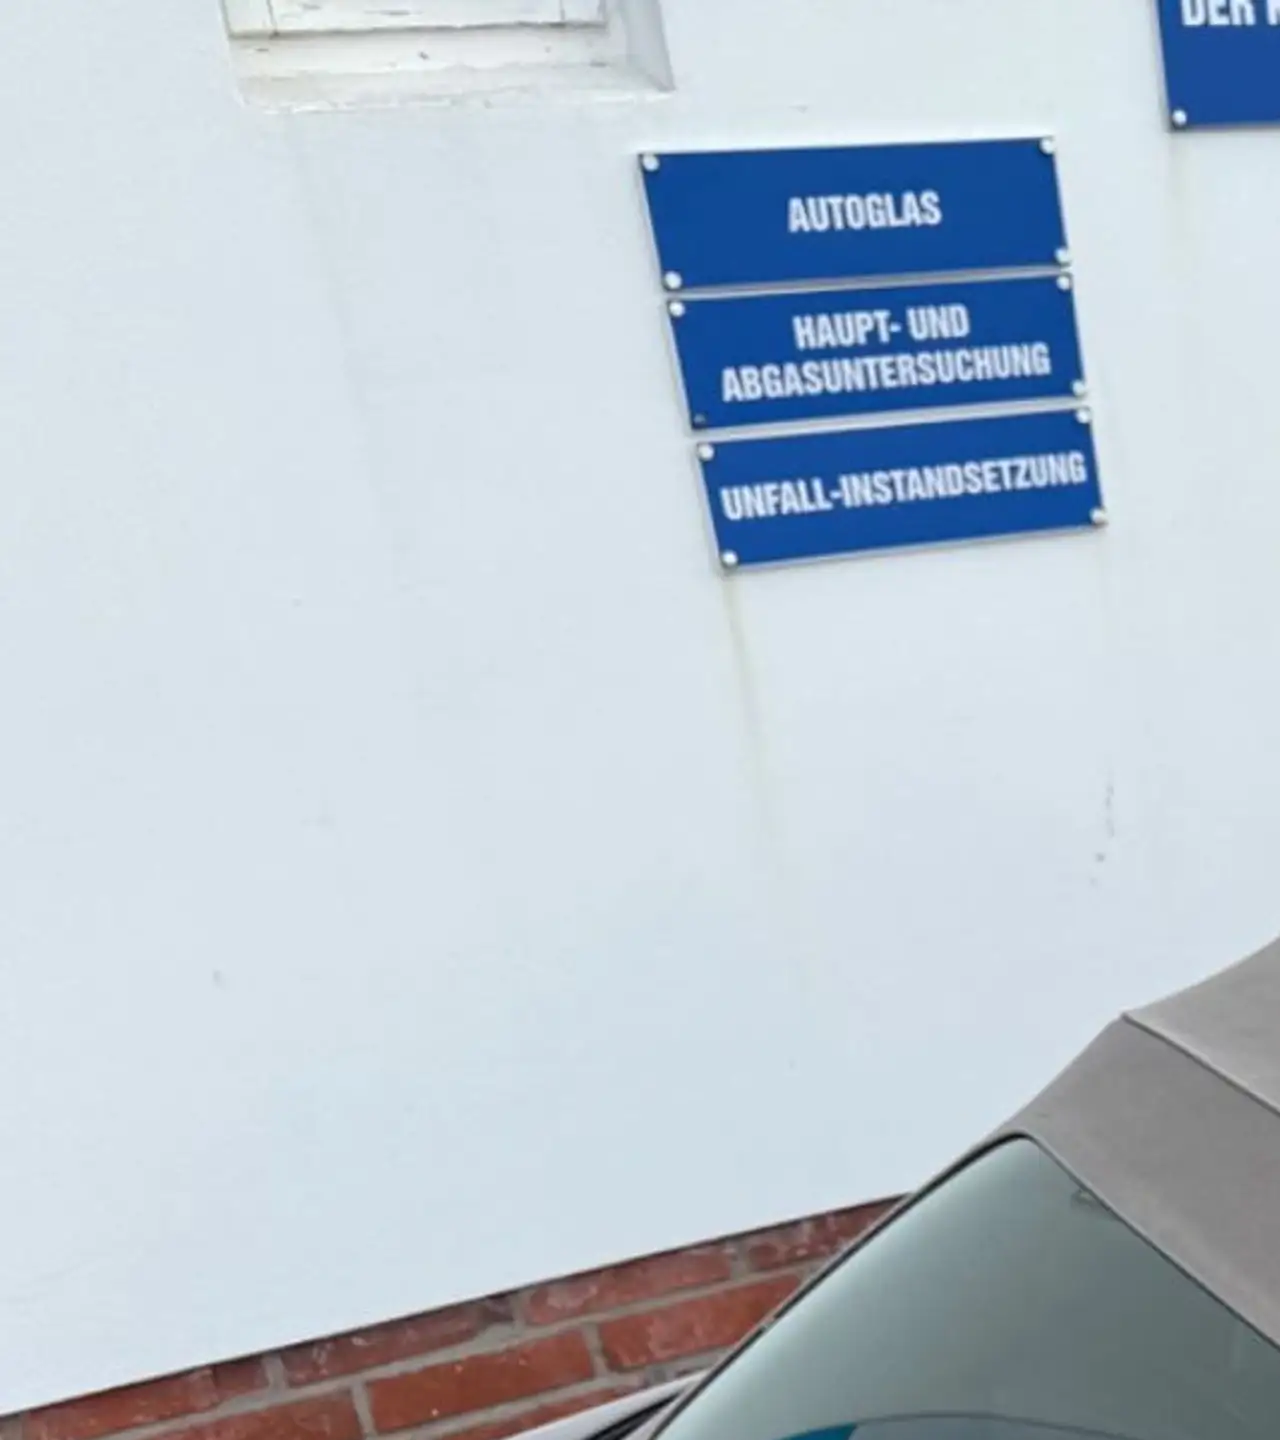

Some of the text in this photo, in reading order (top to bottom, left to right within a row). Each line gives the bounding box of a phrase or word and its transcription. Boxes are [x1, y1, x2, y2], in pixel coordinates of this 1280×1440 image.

[1180, 0, 1256, 26] DER
[788, 190, 943, 233] AUTOGLAS
[792, 304, 970, 350] HAUPT- UND
[721, 341, 1051, 403] ABGASUNTERSUCHUNG
[720, 451, 1087, 521] UNFALL-INSTANDSETZUNG
